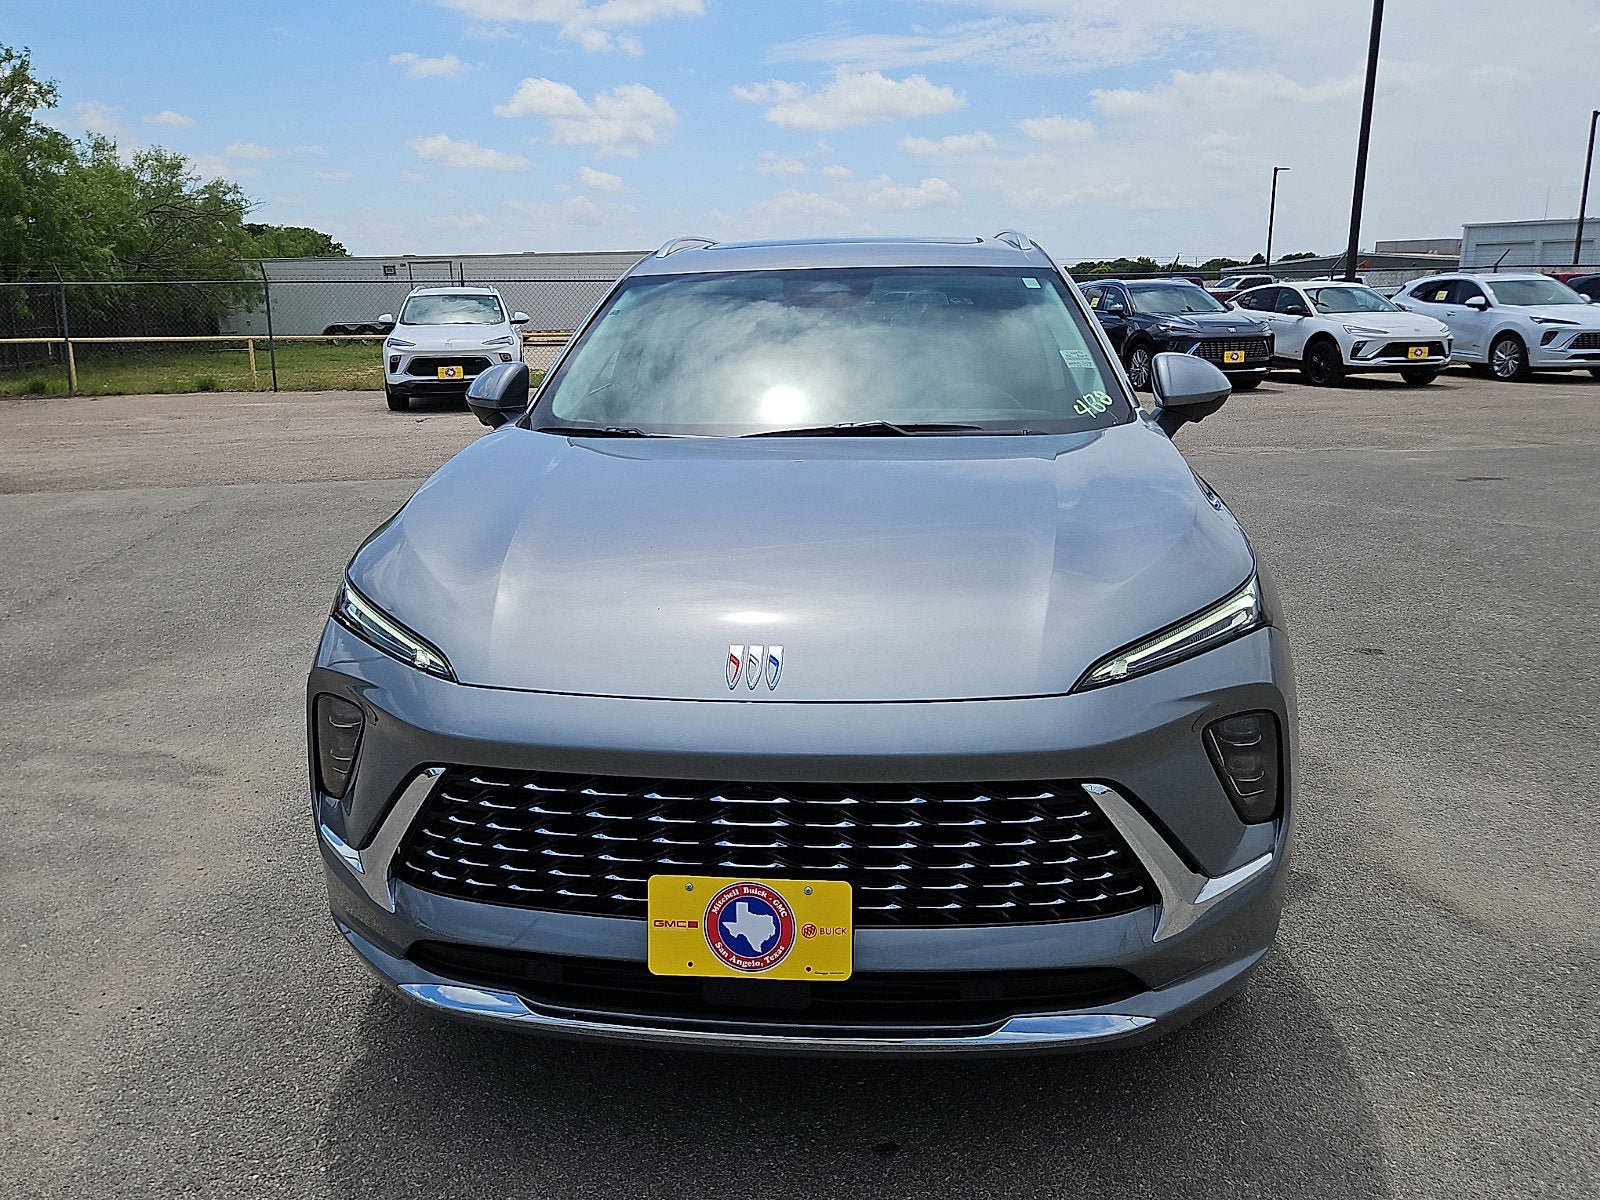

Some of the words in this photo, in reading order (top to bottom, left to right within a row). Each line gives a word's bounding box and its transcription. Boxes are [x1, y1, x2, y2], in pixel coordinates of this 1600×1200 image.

[711, 888, 740, 914] Mitchell
[743, 886, 768, 898] Buick
[772, 899, 788, 918] GMC
[653, 920, 687, 928] GMC
[820, 927, 848, 936] BUICK
[715, 941, 729, 958] San
[729, 956, 764, 968] Angelo,
[763, 945, 785, 964] Texas
